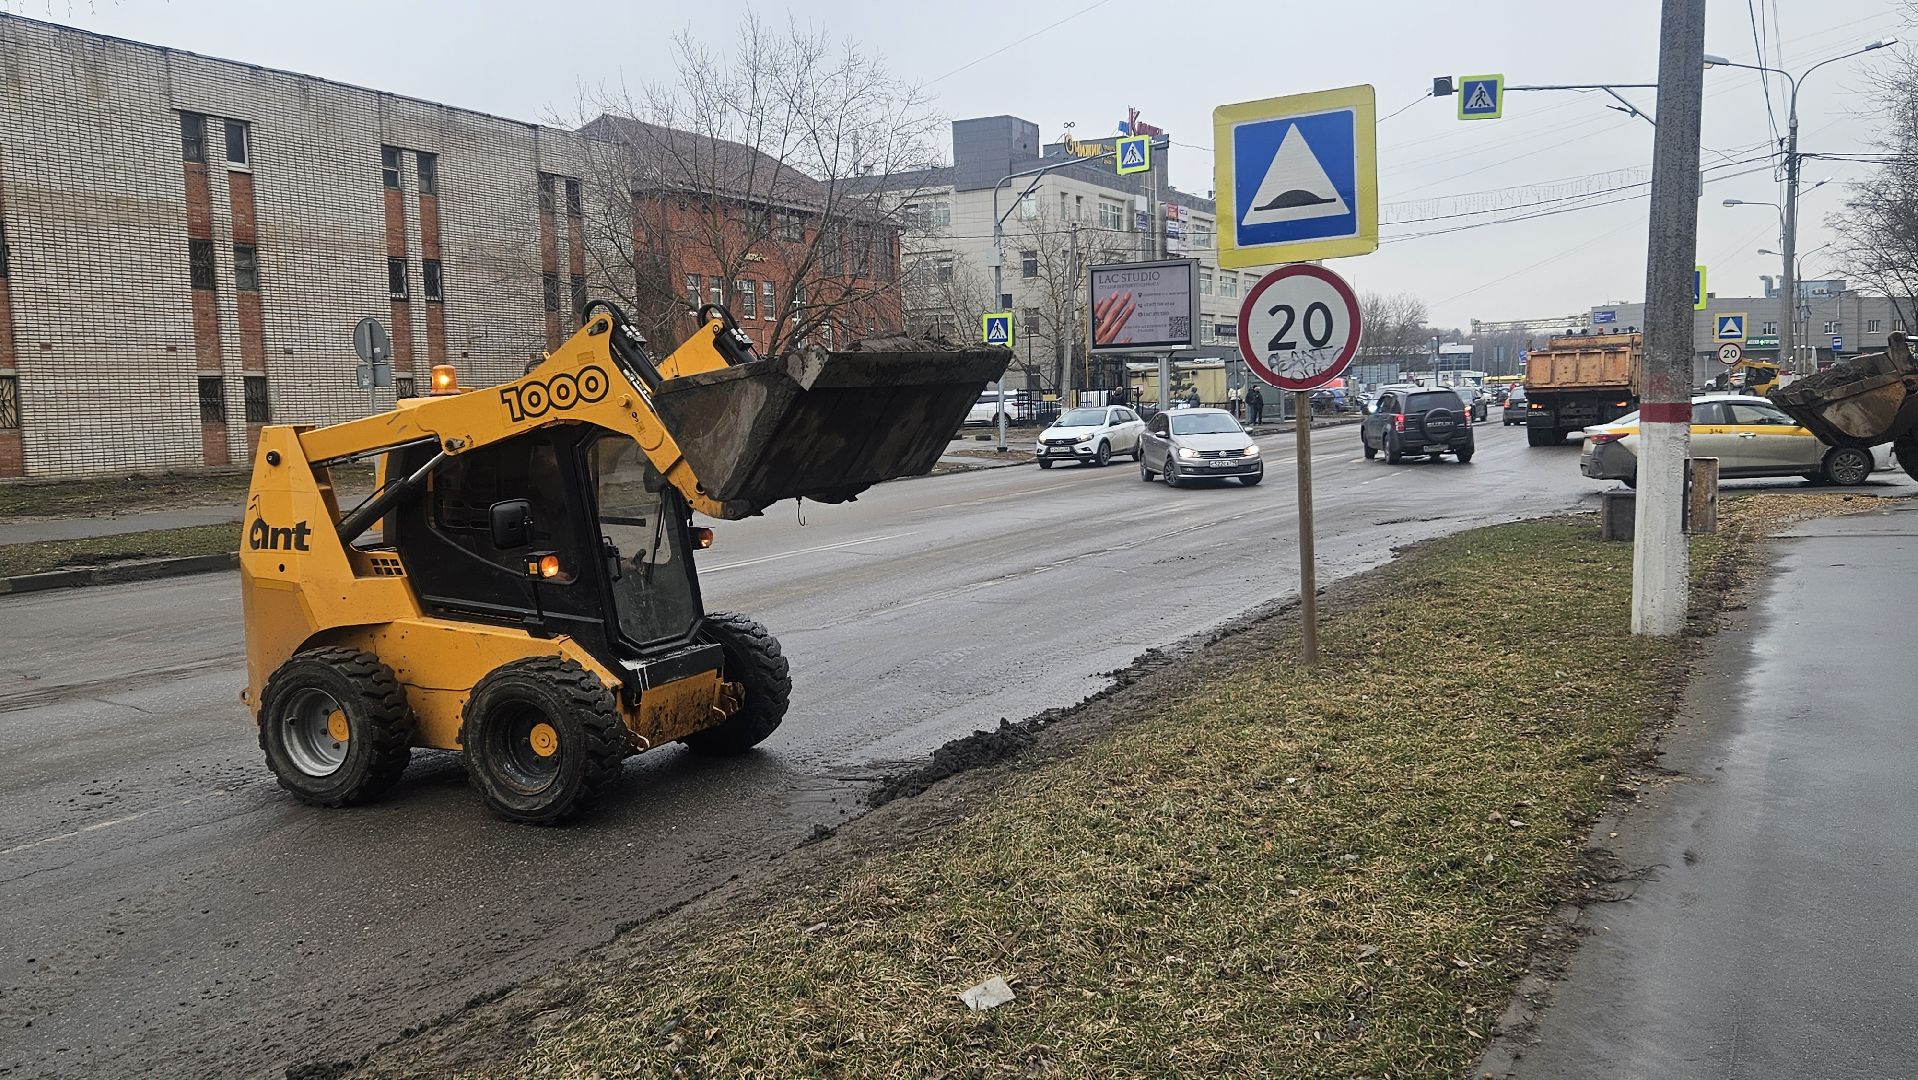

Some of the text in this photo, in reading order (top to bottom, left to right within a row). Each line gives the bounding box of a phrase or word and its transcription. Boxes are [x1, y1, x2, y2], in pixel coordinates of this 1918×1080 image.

[1098, 271, 1160, 284] LAC STUDIO
[1268, 301, 1333, 351] 20
[1723, 349, 1737, 358] 20
[499, 365, 610, 422] 1000
[249, 516, 312, 551] ant
